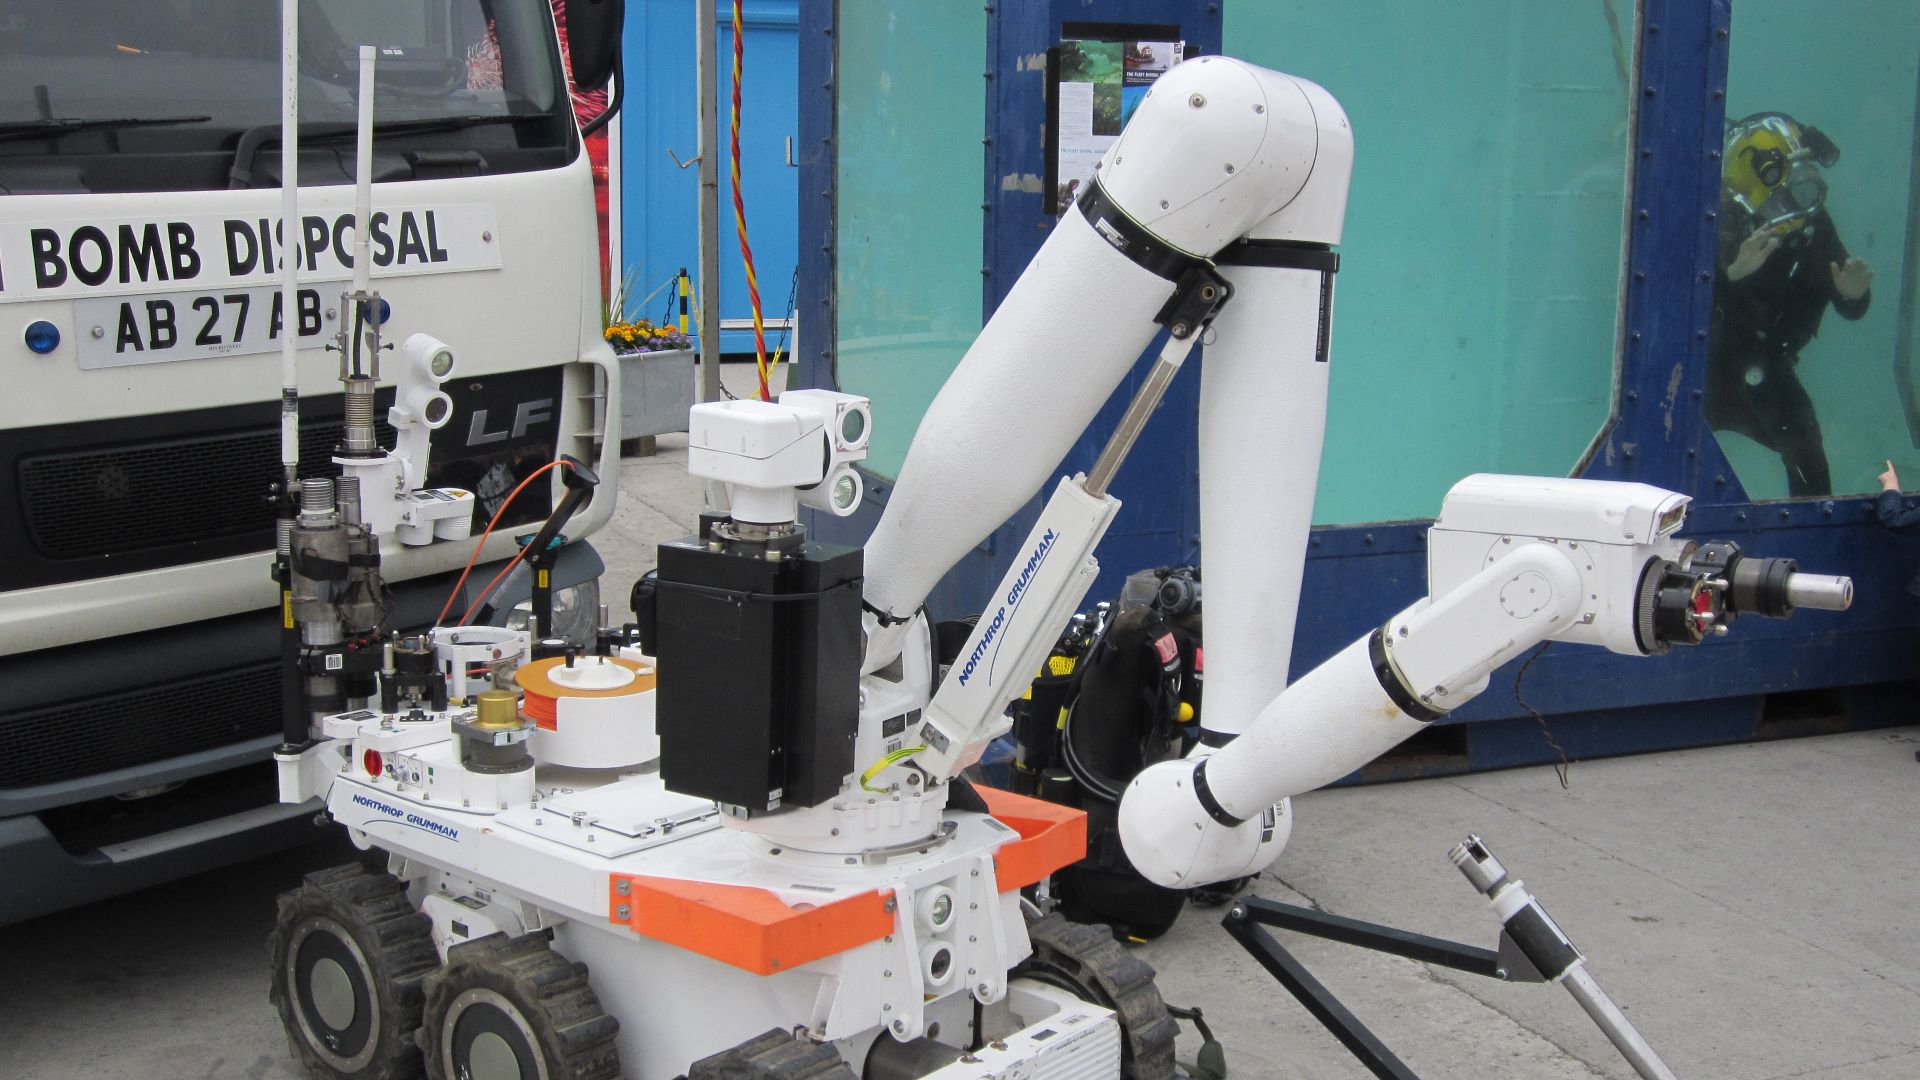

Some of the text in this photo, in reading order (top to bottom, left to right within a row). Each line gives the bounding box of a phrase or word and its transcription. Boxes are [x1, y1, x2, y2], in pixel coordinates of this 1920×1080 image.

[30, 221, 202, 289] BOMB
[115, 299, 178, 354] AB
[191, 293, 250, 346] 27
[466, 397, 554, 447] LF
[958, 528, 1055, 687] NORTHROP GRUMMAN
[352, 794, 459, 838] NORTHROP GRUMMAN
